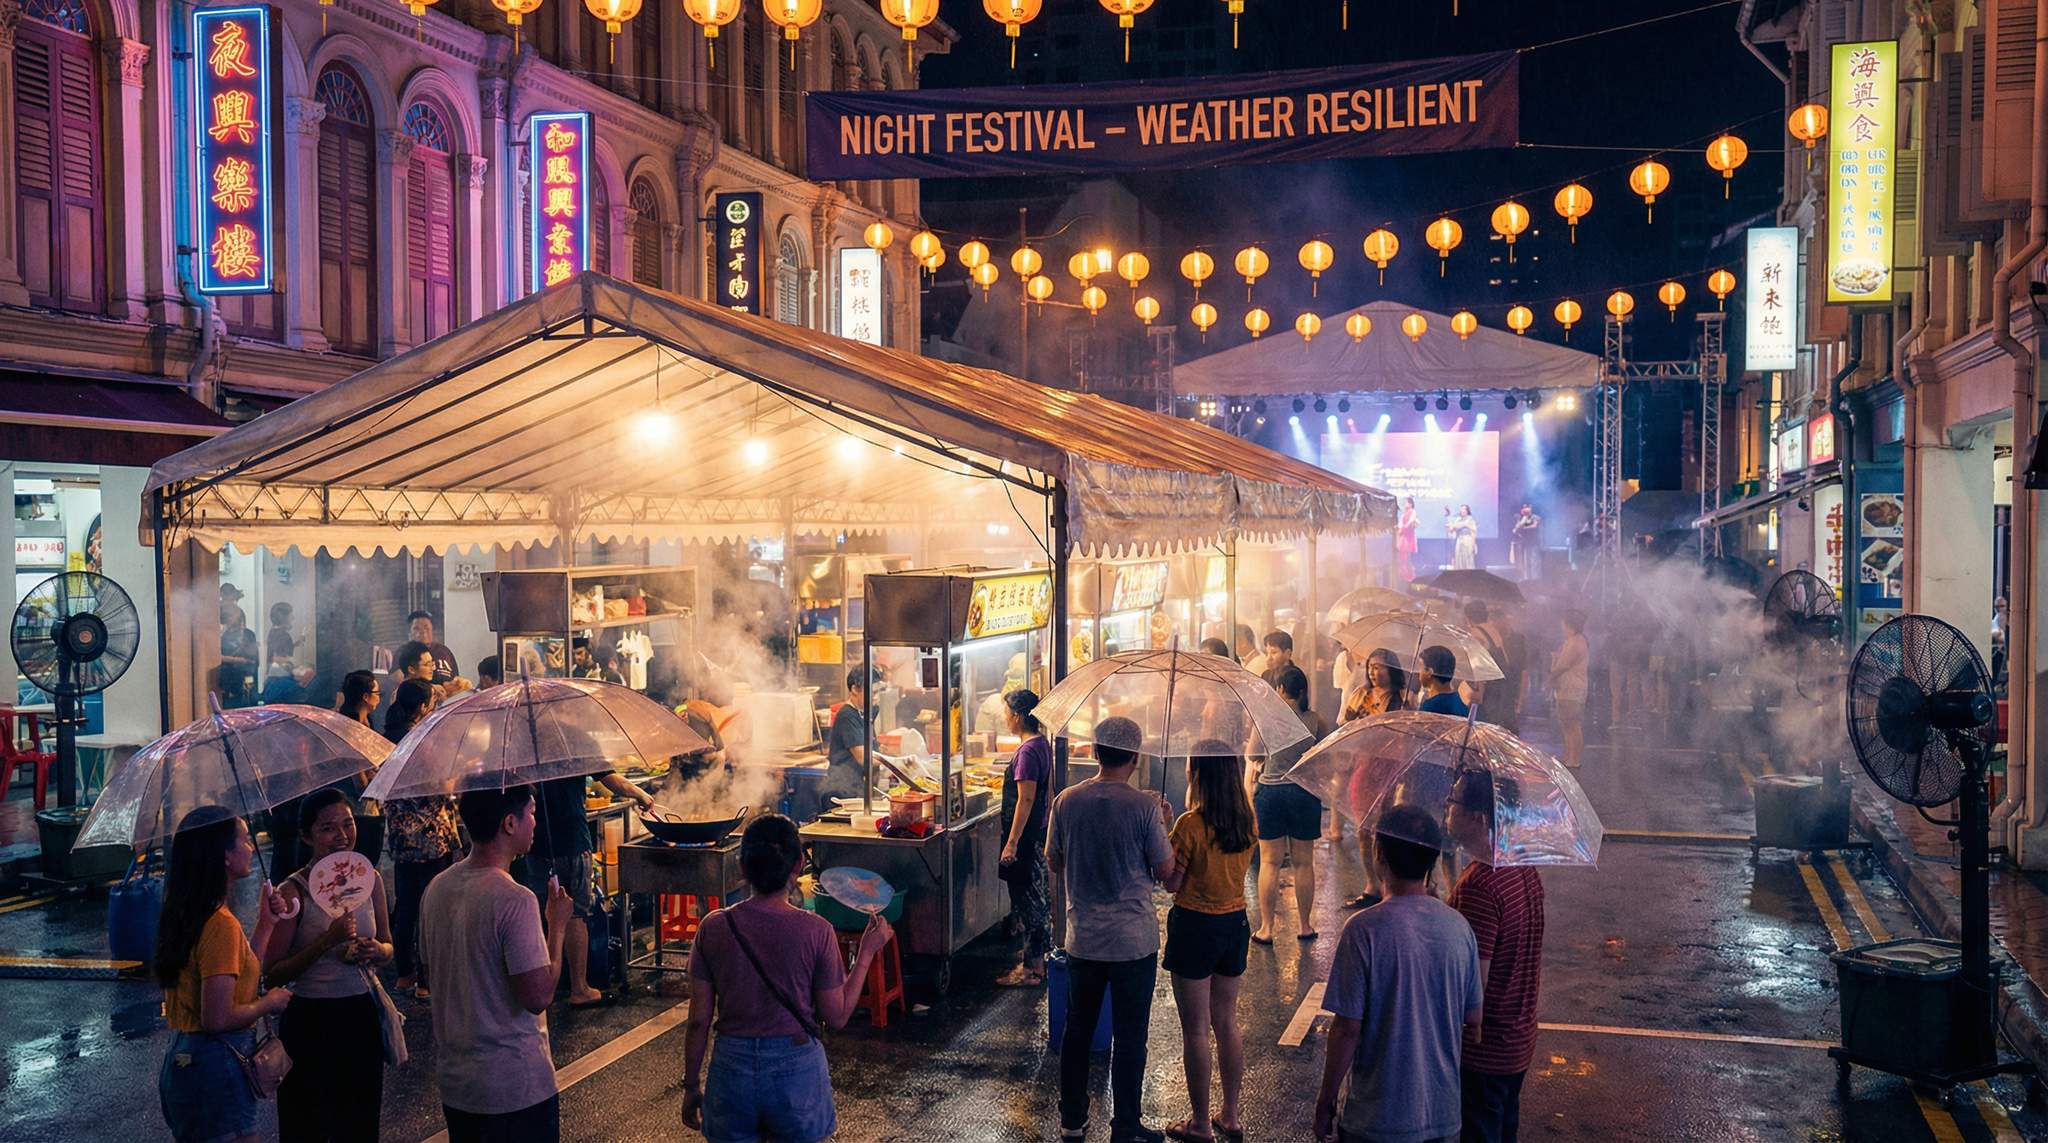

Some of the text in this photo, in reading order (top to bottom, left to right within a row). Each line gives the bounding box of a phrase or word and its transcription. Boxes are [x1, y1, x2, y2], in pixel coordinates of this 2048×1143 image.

[840, 114, 936, 155] NIGHT
[946, 109, 1095, 153] FESTIVAL
[1137, 96, 1295, 145] WEATHER
[1307, 79, 1483, 135] RESILIENT
[1848, 48, 1880, 142] 海興食
